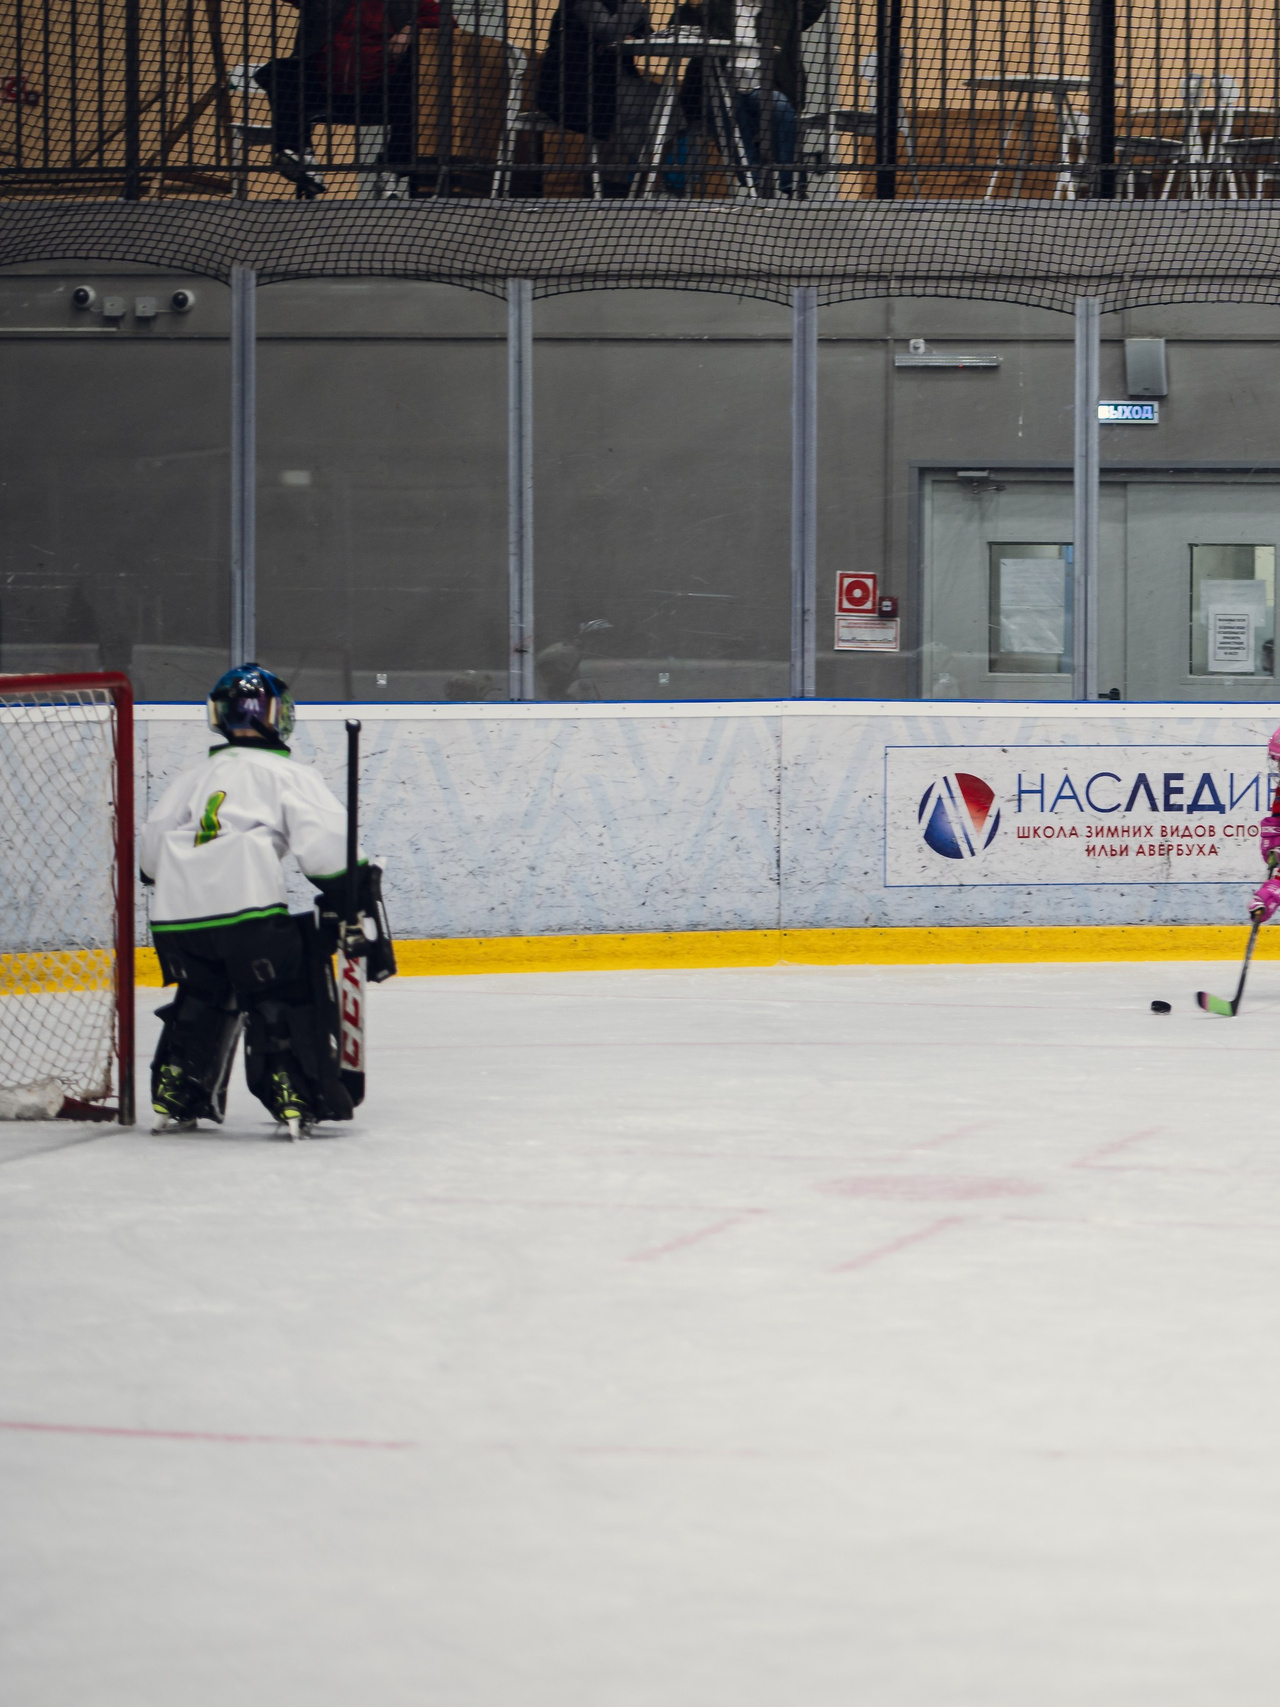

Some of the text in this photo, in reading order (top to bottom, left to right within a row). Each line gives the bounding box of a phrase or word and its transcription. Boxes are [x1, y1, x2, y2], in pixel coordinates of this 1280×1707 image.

[1017, 825, 1079, 839] ШКОЛА
[1085, 825, 1155, 838] ЗИМНИХ
[1160, 825, 1217, 840] ВИДОВ
[1223, 824, 1260, 838] СПО
[1086, 843, 1219, 857] ИЛЬИ АВЕРБУХА
